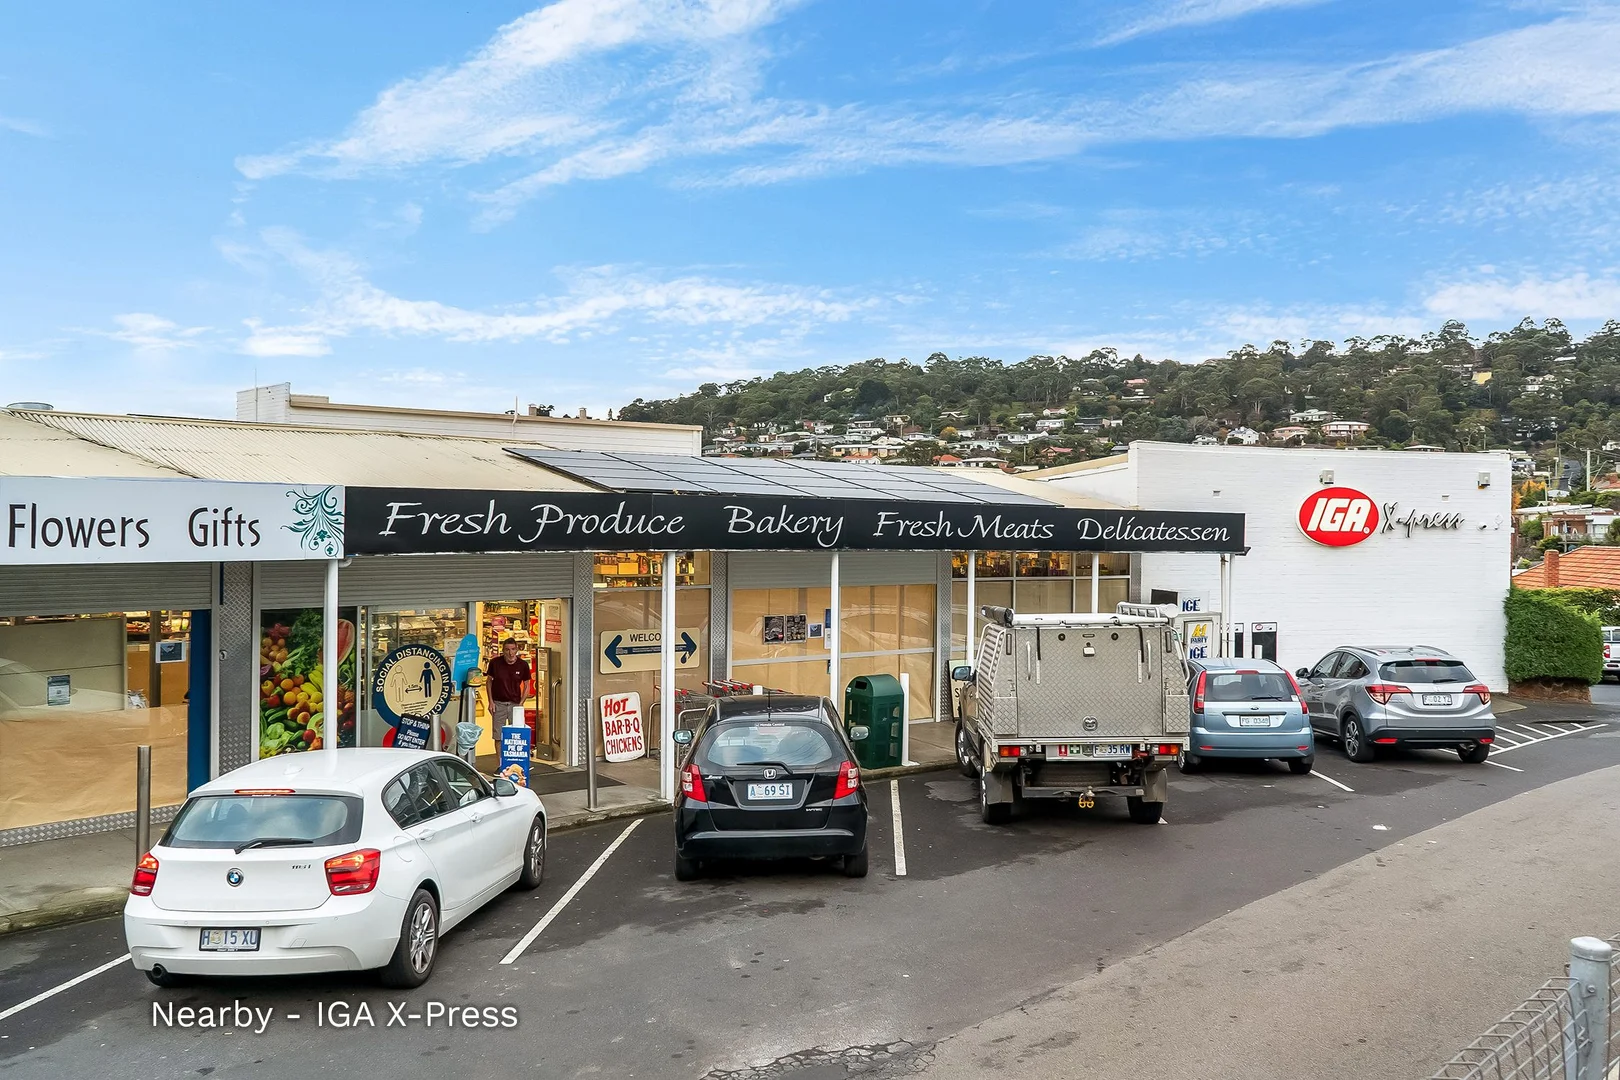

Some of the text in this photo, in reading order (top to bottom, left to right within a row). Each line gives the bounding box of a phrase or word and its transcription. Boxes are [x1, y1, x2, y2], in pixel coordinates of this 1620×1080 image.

[1307, 498, 1371, 532] IGA
[8, 502, 260, 549] Flowers Gifts
[378, 499, 1230, 548] Fresh Produce Bakery Fresh Meats Delicatessen
[1182, 599, 1201, 612] ICE
[629, 632, 662, 642] WELCO
[1189, 646, 1208, 659] ICE
[376, 658, 397, 692] SOCIAL
[396, 648, 446, 672] DISTANCING
[442, 673, 450, 683] IN
[604, 698, 629, 717] HOT
[401, 717, 414, 726] STOP
[411, 737, 426, 745] ENTER
[605, 736, 643, 755] CHICKENS
[1108, 745, 1118, 754] 35
[750, 785, 790, 796] A 69 SI
[202, 930, 258, 945] H 15 XU
